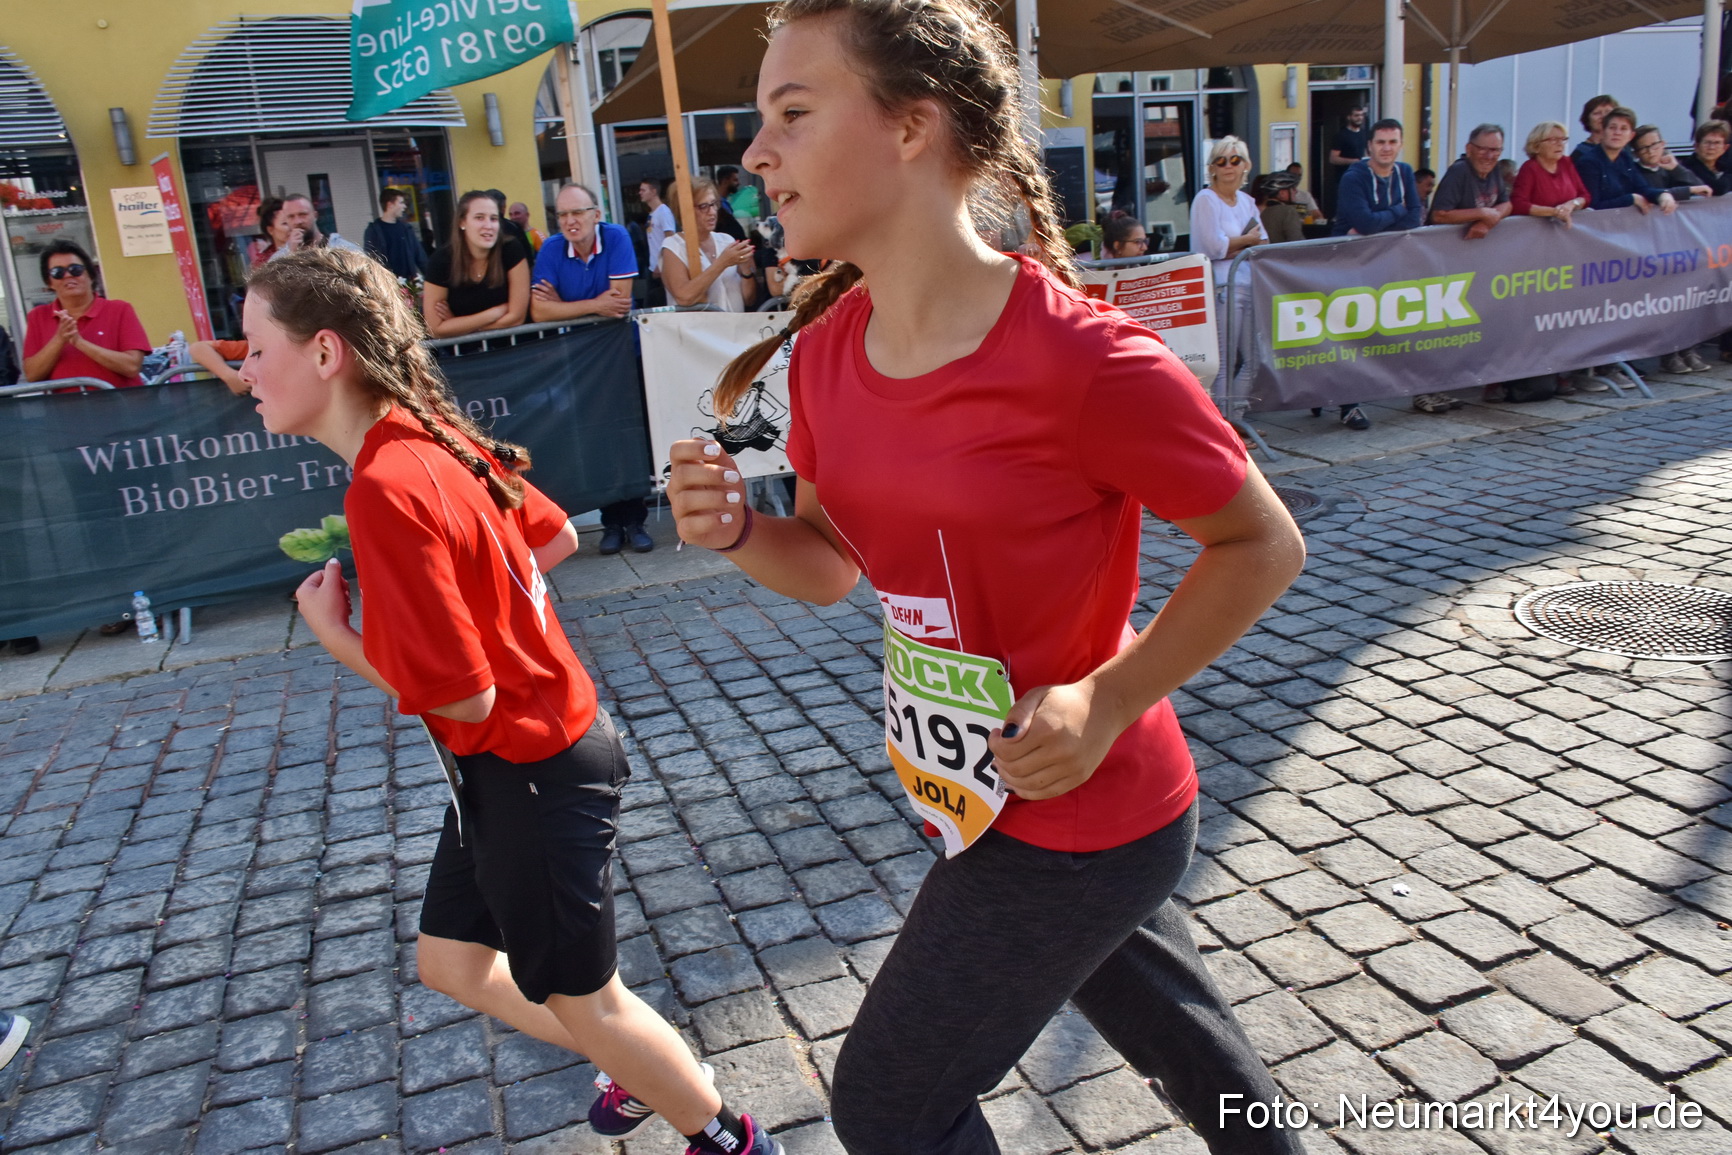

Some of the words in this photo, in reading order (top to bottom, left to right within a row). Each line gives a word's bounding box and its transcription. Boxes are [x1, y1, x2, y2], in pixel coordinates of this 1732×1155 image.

[118, 201, 159, 211] hailer
[1120, 273, 1171, 290] BINDESTRICKE
[1490, 264, 1574, 300] OFFICE
[1581, 248, 1700, 287] INDUSTRY
[1707, 244, 1732, 269] LO
[1118, 286, 1187, 304] VERZURRSYSTEME
[1277, 279, 1471, 342] BOCK
[1272, 347, 1337, 371] inspired
[1341, 347, 1357, 363] by
[1362, 340, 1411, 358] smart
[1415, 331, 1482, 350] concepts
[452, 395, 511, 421] en
[891, 605, 923, 626] DEHN
[889, 685, 998, 791] 5192
[913, 776, 966, 822] JOLA
[712, 1129, 740, 1153] NIKE
